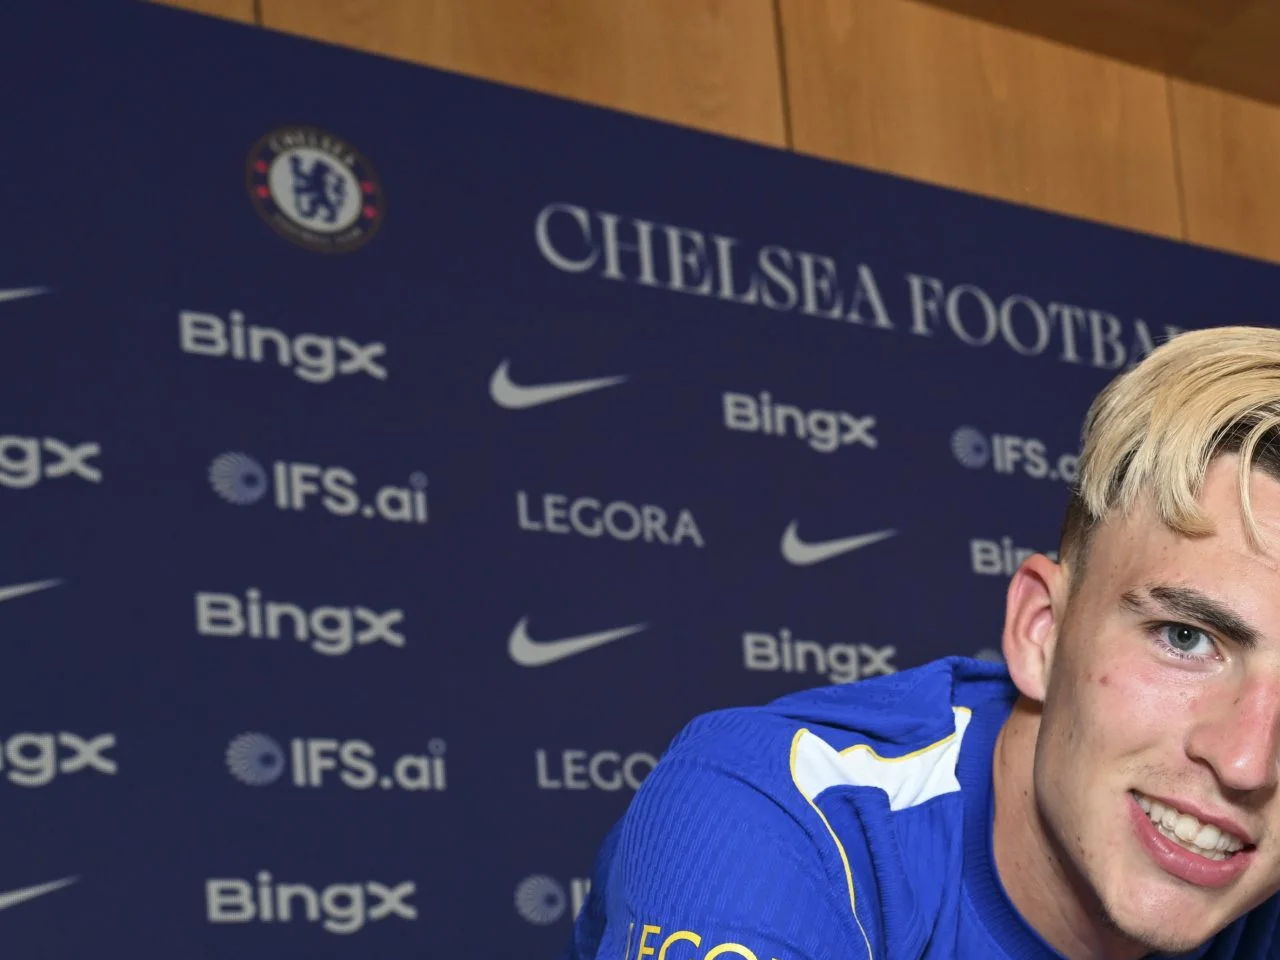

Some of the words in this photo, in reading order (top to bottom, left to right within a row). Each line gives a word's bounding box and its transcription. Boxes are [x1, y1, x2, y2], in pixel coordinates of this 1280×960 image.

[534, 203, 894, 330] CHELSEA
[906, 273, 1180, 370] FOOTBA
[991, 433, 1080, 484] IFS.a
[274, 460, 428, 523] IFS.ai
[516, 491, 705, 547] LEGORA
[291, 738, 446, 791] IFS.ai
[535, 749, 659, 791] LEGO
